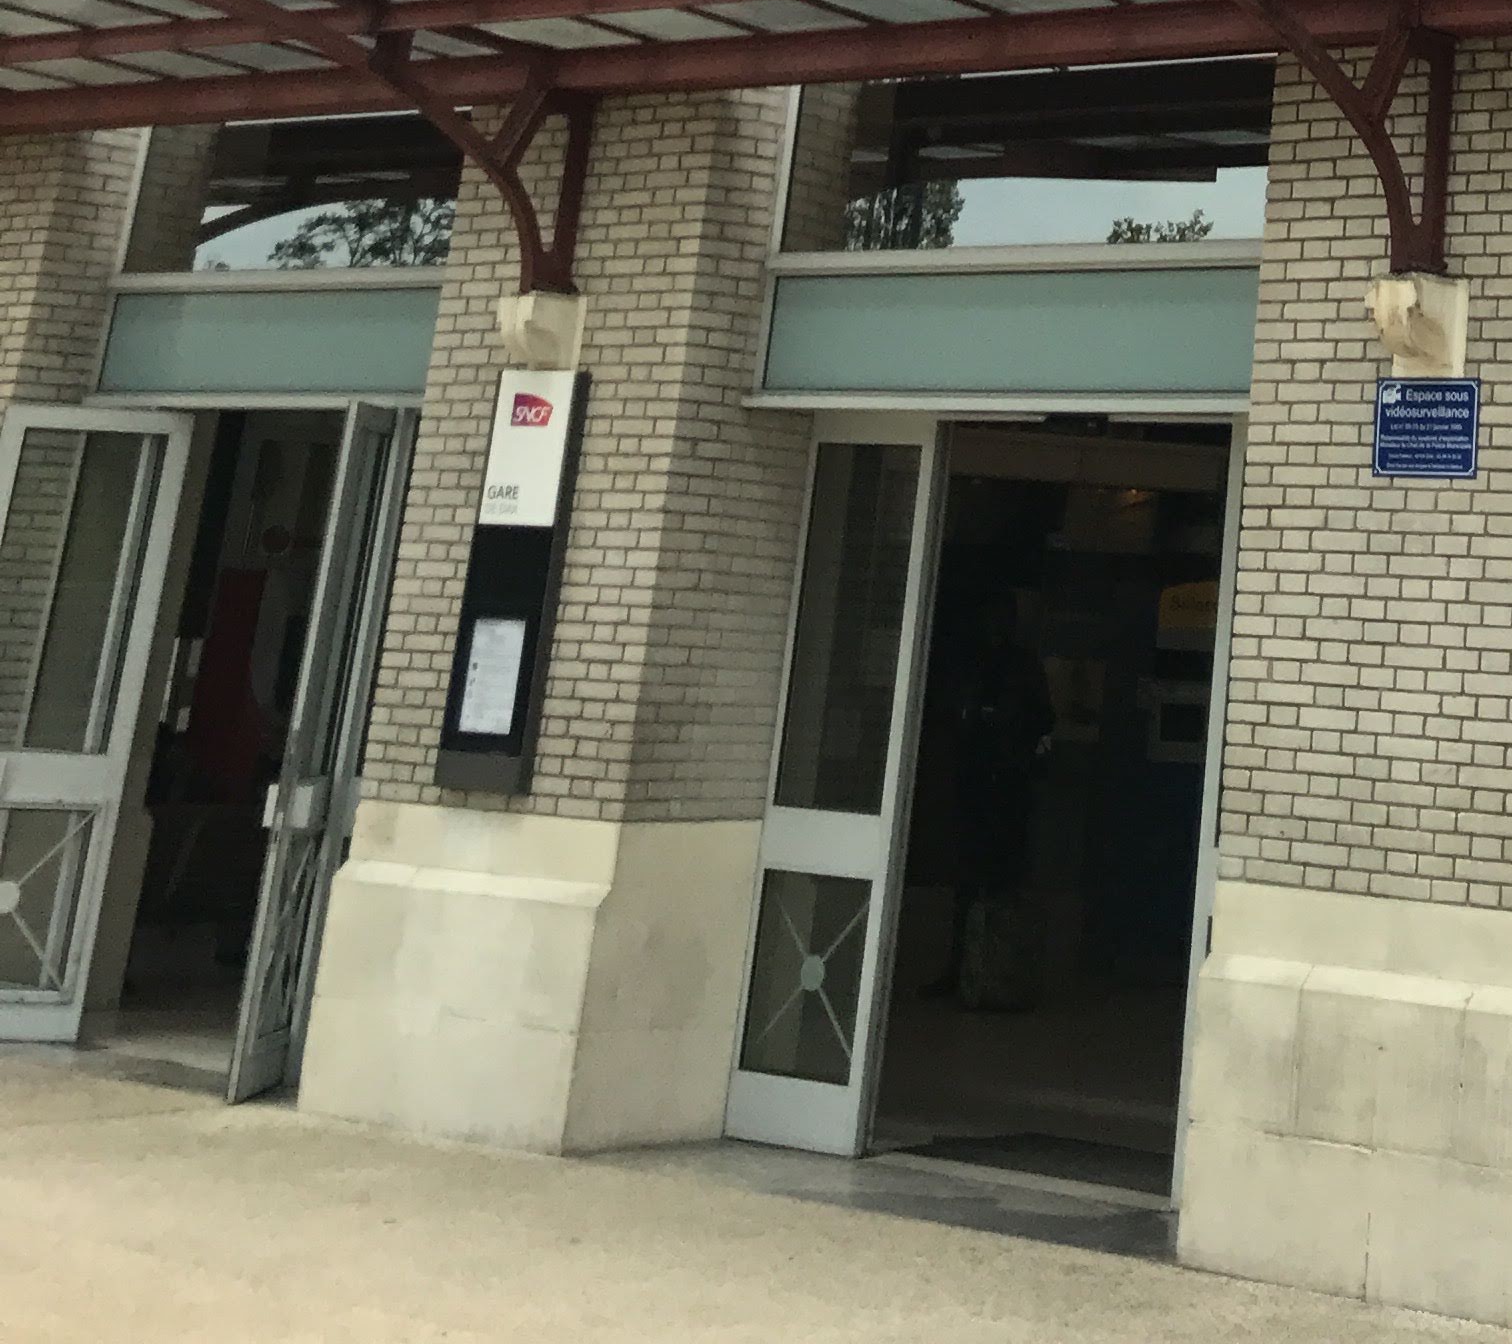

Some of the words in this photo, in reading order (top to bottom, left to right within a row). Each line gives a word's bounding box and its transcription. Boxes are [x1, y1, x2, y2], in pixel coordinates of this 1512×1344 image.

[1406, 389, 1442, 402] Espace
[1445, 391, 1469, 401] sous
[513, 406, 551, 422] SNCF
[1385, 405, 1469, 418] vidéosurveillance
[487, 485, 519, 500] GARE
